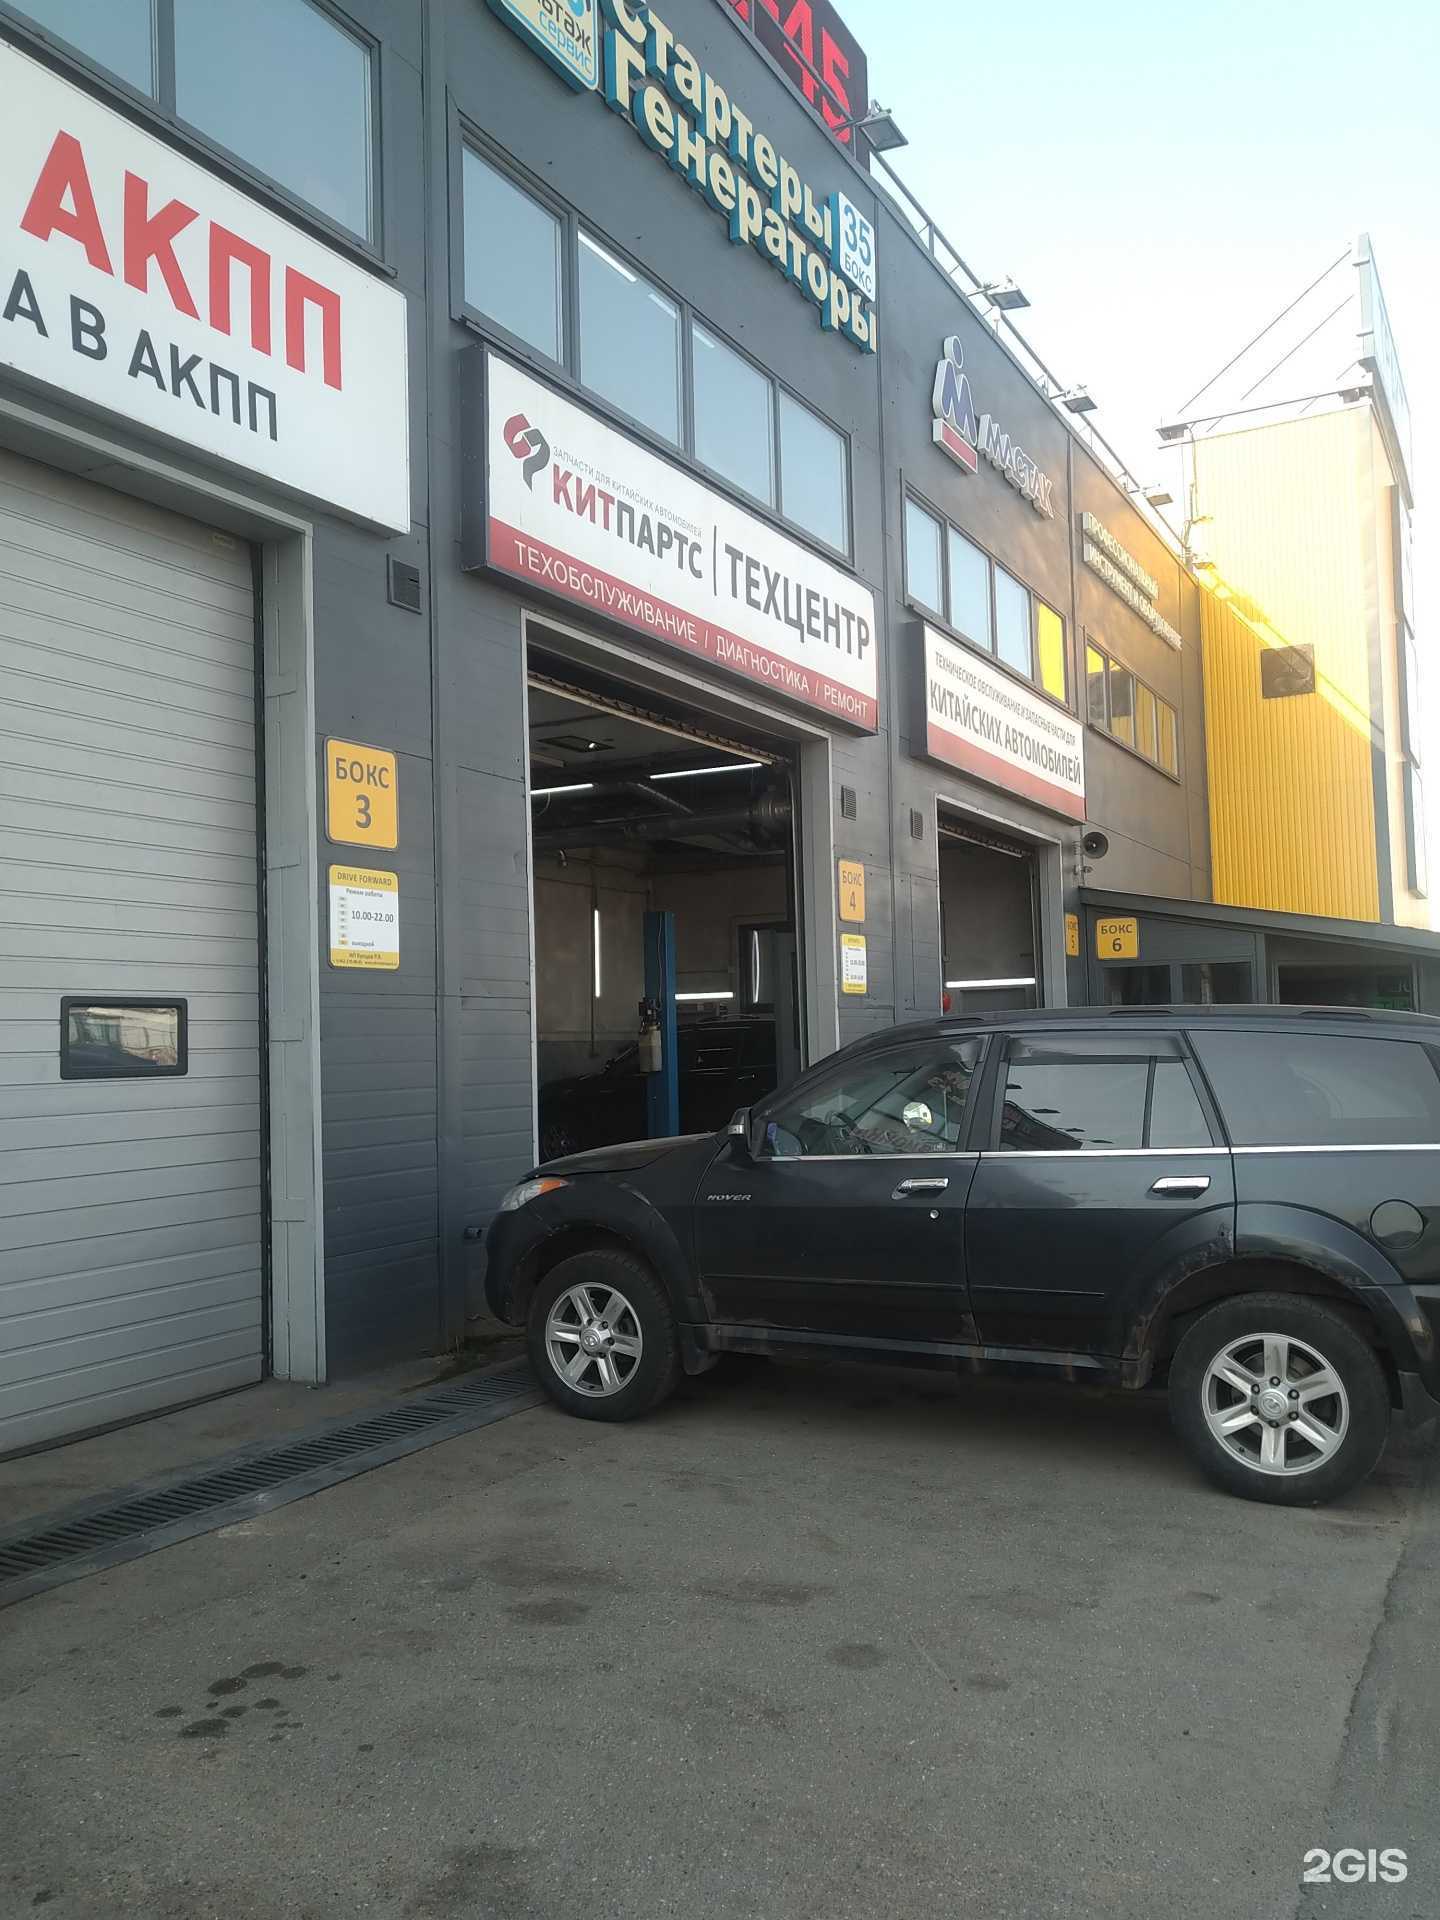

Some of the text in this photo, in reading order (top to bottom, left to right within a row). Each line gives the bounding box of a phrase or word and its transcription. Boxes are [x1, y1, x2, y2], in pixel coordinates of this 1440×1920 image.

[540, 11, 592, 75] сервис
[612, 29, 876, 354] Генераторы
[20, 129, 342, 391] АКПП
[844, 204, 871, 266] 35
[845, 252, 872, 294] БОКС
[70, 294, 108, 361] В
[127, 329, 278, 441] АКПП
[553, 446, 594, 479] ЗАПЧАСТИ
[595, 469, 611, 486] ДЛЯ
[612, 481, 653, 512] КИТАЙСКИХ
[552, 463, 870, 660] КИТПАРТС ТЕХЦЕНТР
[514, 540, 698, 645] ТЕХОБСЛУЖИВАНИЕ
[716, 635, 810, 693] ДИАГНОСТИКА
[824, 687, 868, 718] РЕМОНТ
[935, 651, 977, 690] ТЕХНИЧЕСКОЕ
[930, 679, 1081, 785] КИТАЙСКИХ АВТОМОБИЛЕЙ
[335, 757, 390, 789] БОКС
[355, 794, 372, 829] 3
[337, 872, 392, 886] DRIVE FORWARD
[842, 870, 862, 887] БОКС
[849, 891, 857, 911] 4
[1101, 924, 1133, 935] БОКС
[1112, 938, 1122, 952] 6
